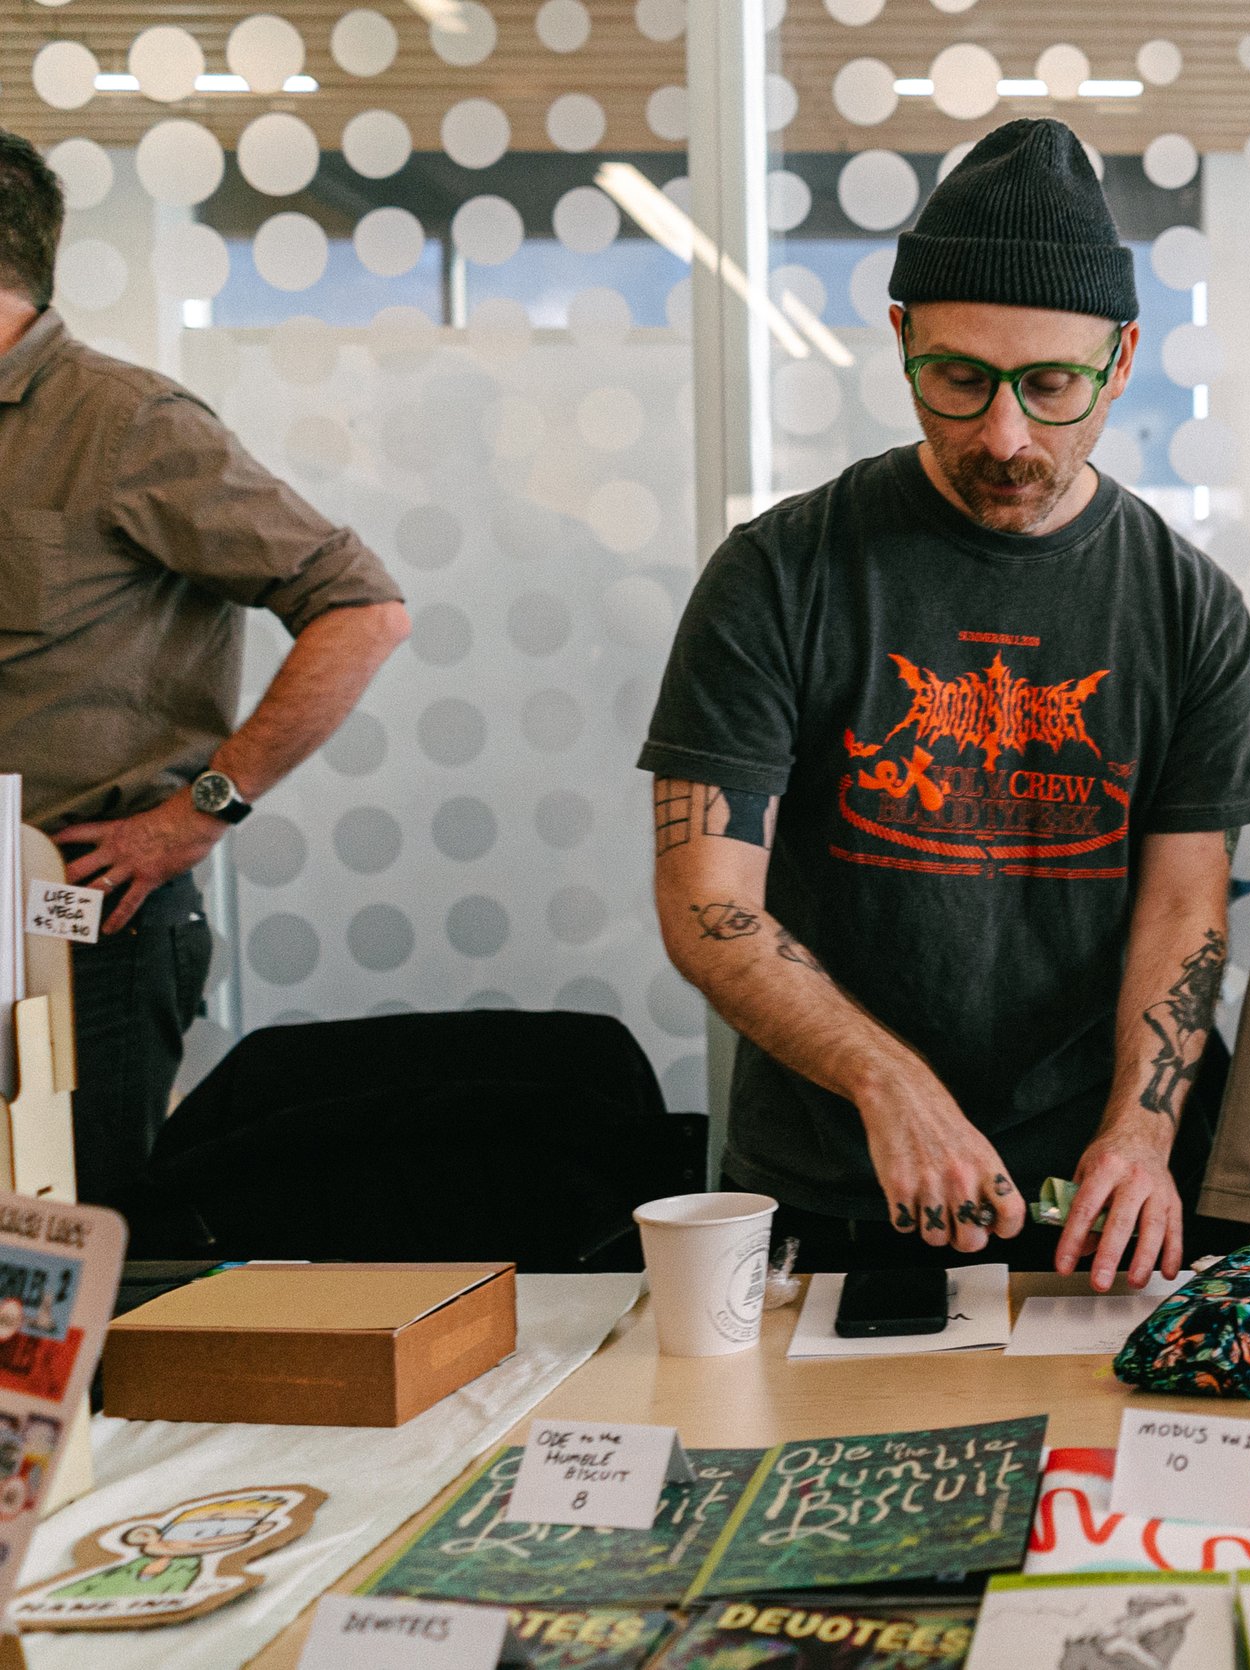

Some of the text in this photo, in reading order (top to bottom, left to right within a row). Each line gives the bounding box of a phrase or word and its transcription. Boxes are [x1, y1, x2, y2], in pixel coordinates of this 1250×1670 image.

[1009, 769, 1096, 804] CREW
[43, 889, 76, 905] LIFE
[537, 1430, 574, 1448] ODE
[579, 1432, 595, 1444] to
[1138, 1422, 1209, 1445] MODUS
[544, 1449, 616, 1467] HUMBLE
[776, 1442, 873, 1475] Ode
[1165, 1452, 1190, 1472] 10
[563, 1468, 632, 1483] BISCUIT
[571, 1490, 589, 1510] 8
[757, 1450, 1025, 1546] Biscuit
